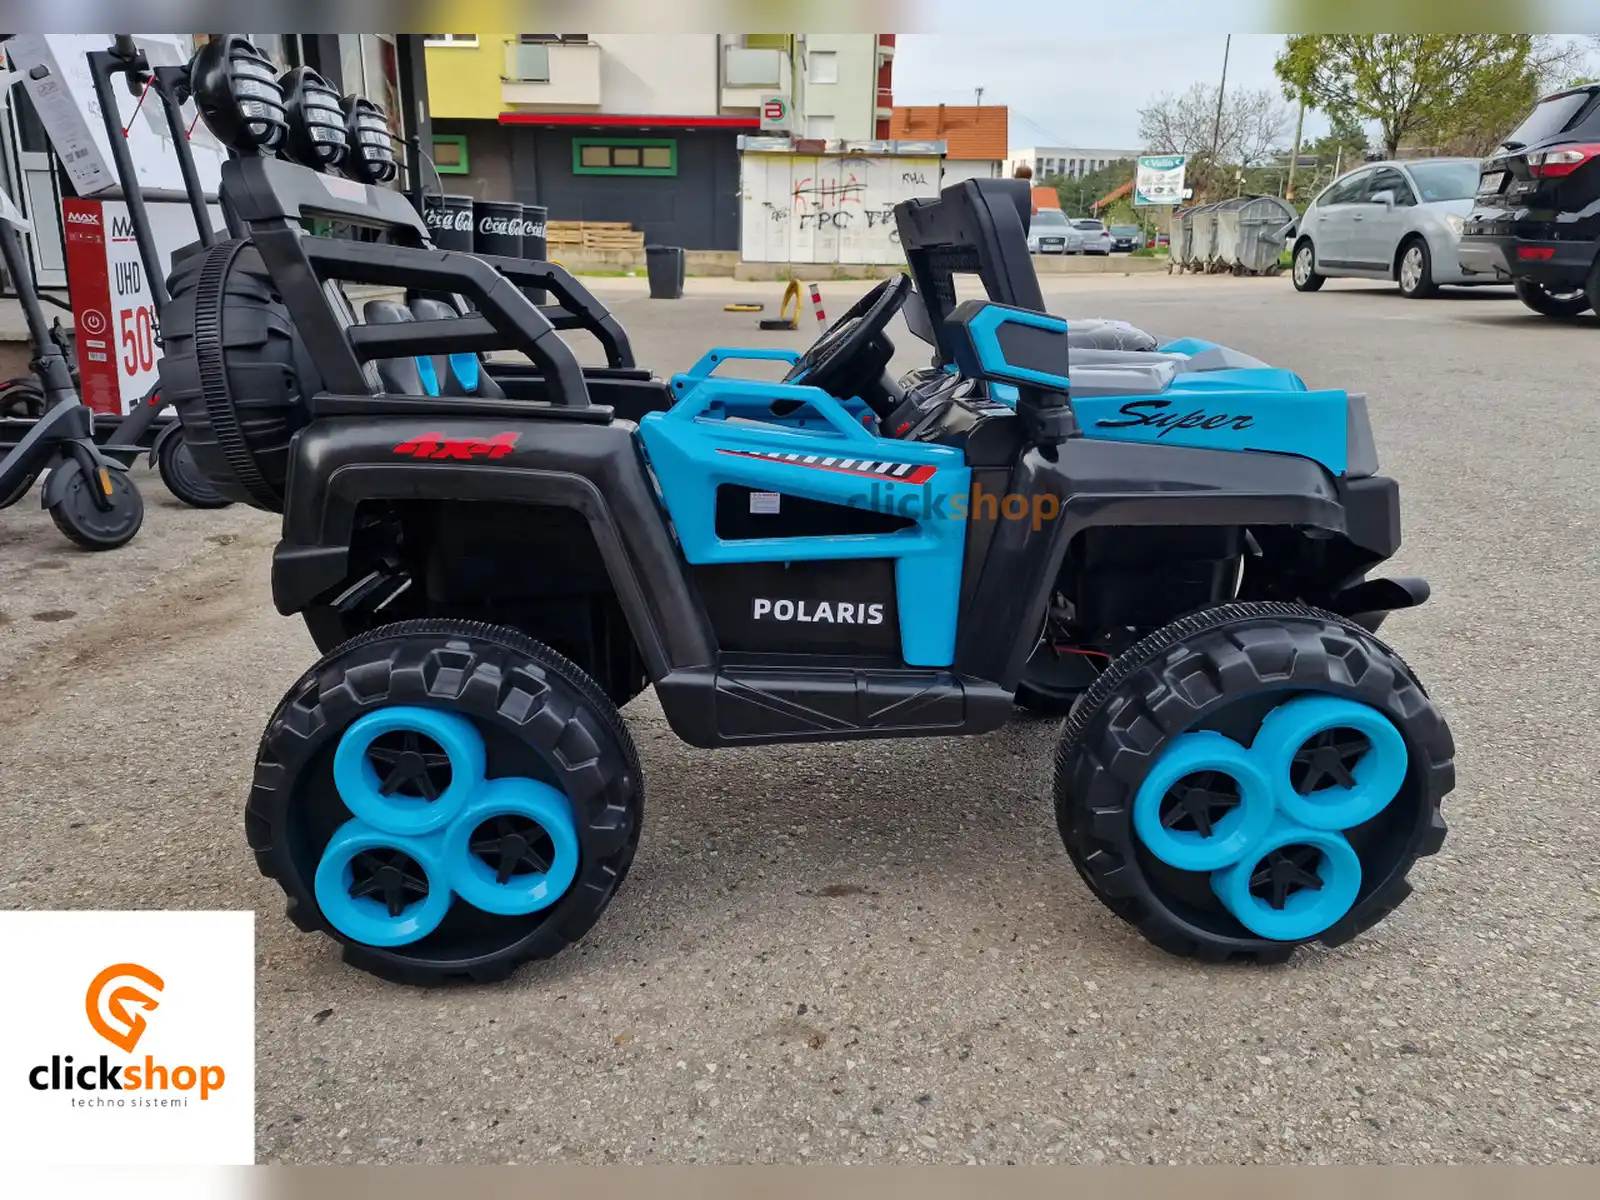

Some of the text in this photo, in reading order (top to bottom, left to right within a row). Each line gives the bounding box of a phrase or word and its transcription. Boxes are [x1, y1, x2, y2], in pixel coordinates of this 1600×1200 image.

[67, 212, 100, 225] MAX
[112, 216, 137, 237] MA
[480, 217, 508, 234] Coca
[115, 261, 140, 296] UHD
[1094, 400, 1255, 438] Super
[753, 599, 885, 625] POLARIS
